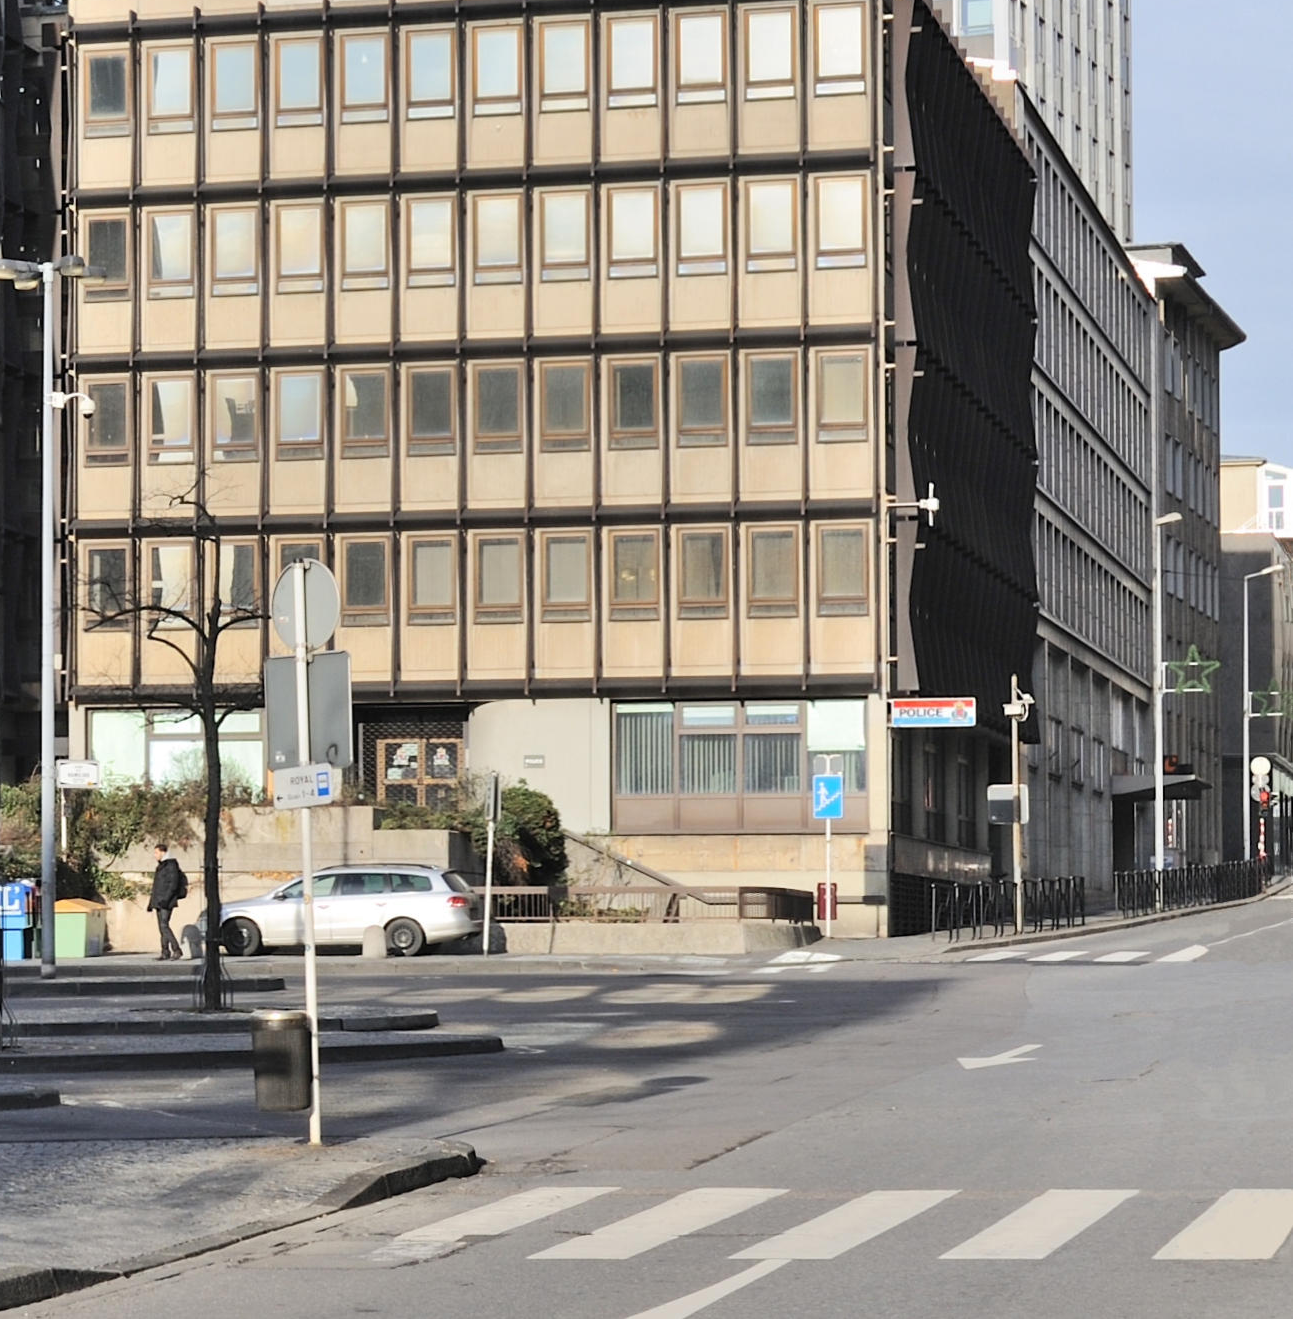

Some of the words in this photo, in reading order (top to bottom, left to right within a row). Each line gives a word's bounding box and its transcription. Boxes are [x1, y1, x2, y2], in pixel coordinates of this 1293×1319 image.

[899, 708, 943, 718] POLICE
[290, 775, 313, 785] ROYAL
[302, 788, 315, 799] 1-4
